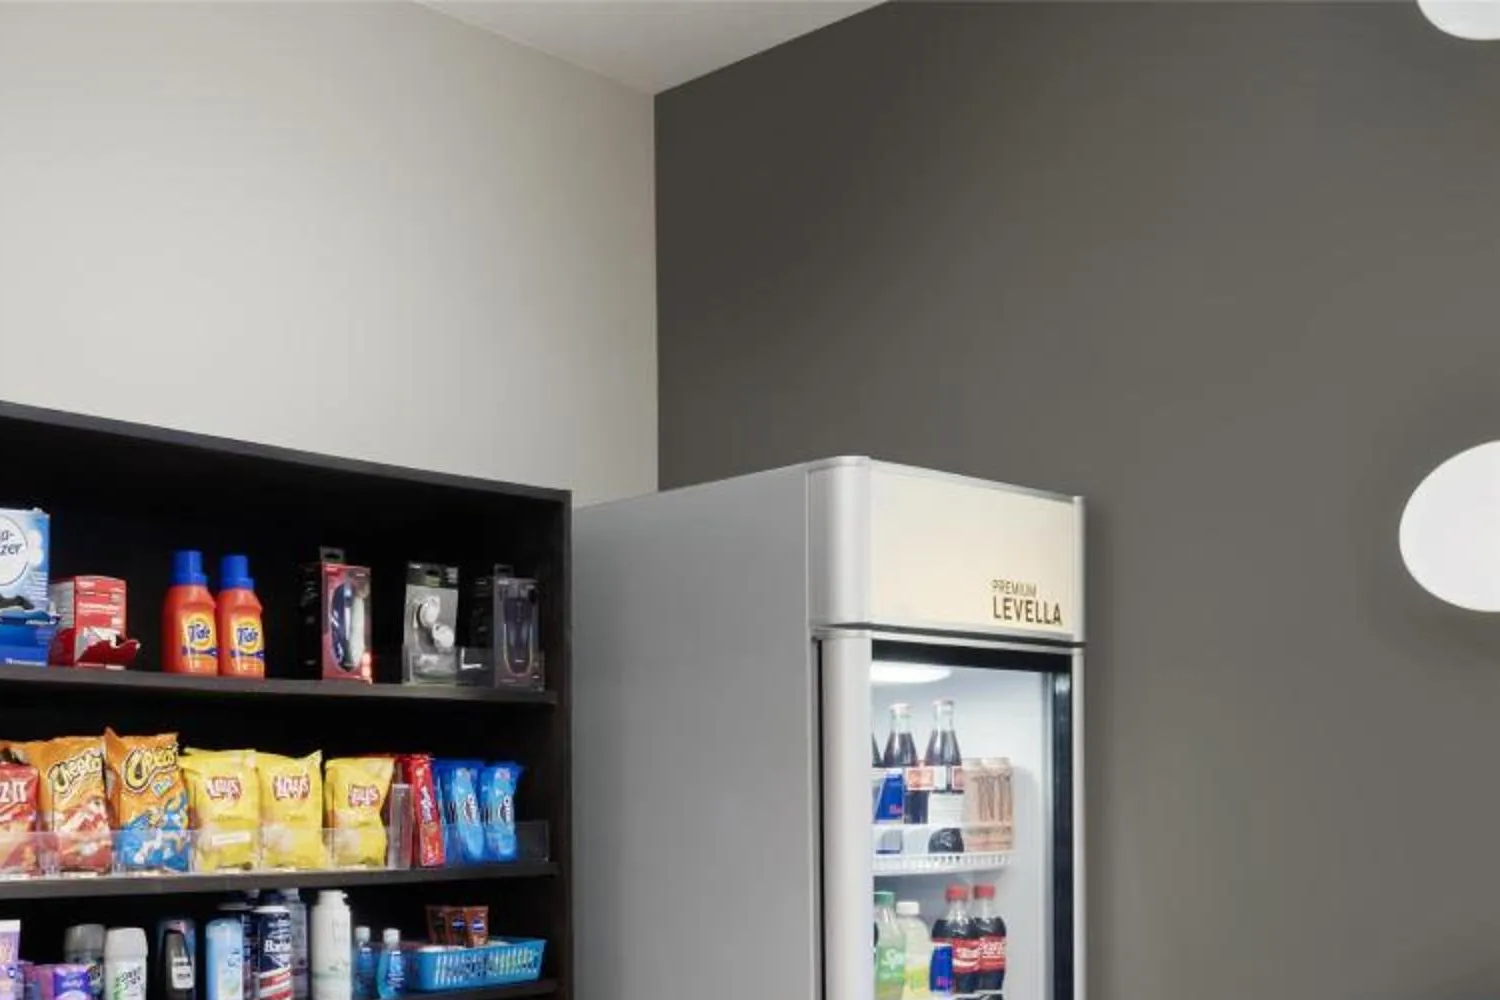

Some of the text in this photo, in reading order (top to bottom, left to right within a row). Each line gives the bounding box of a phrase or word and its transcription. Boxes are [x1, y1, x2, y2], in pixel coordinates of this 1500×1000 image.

[992, 578, 1037, 598] PREMIUM
[992, 596, 1063, 626] LEVELLA
[188, 623, 211, 642] Tide
[236, 627, 259, 646] Tide
